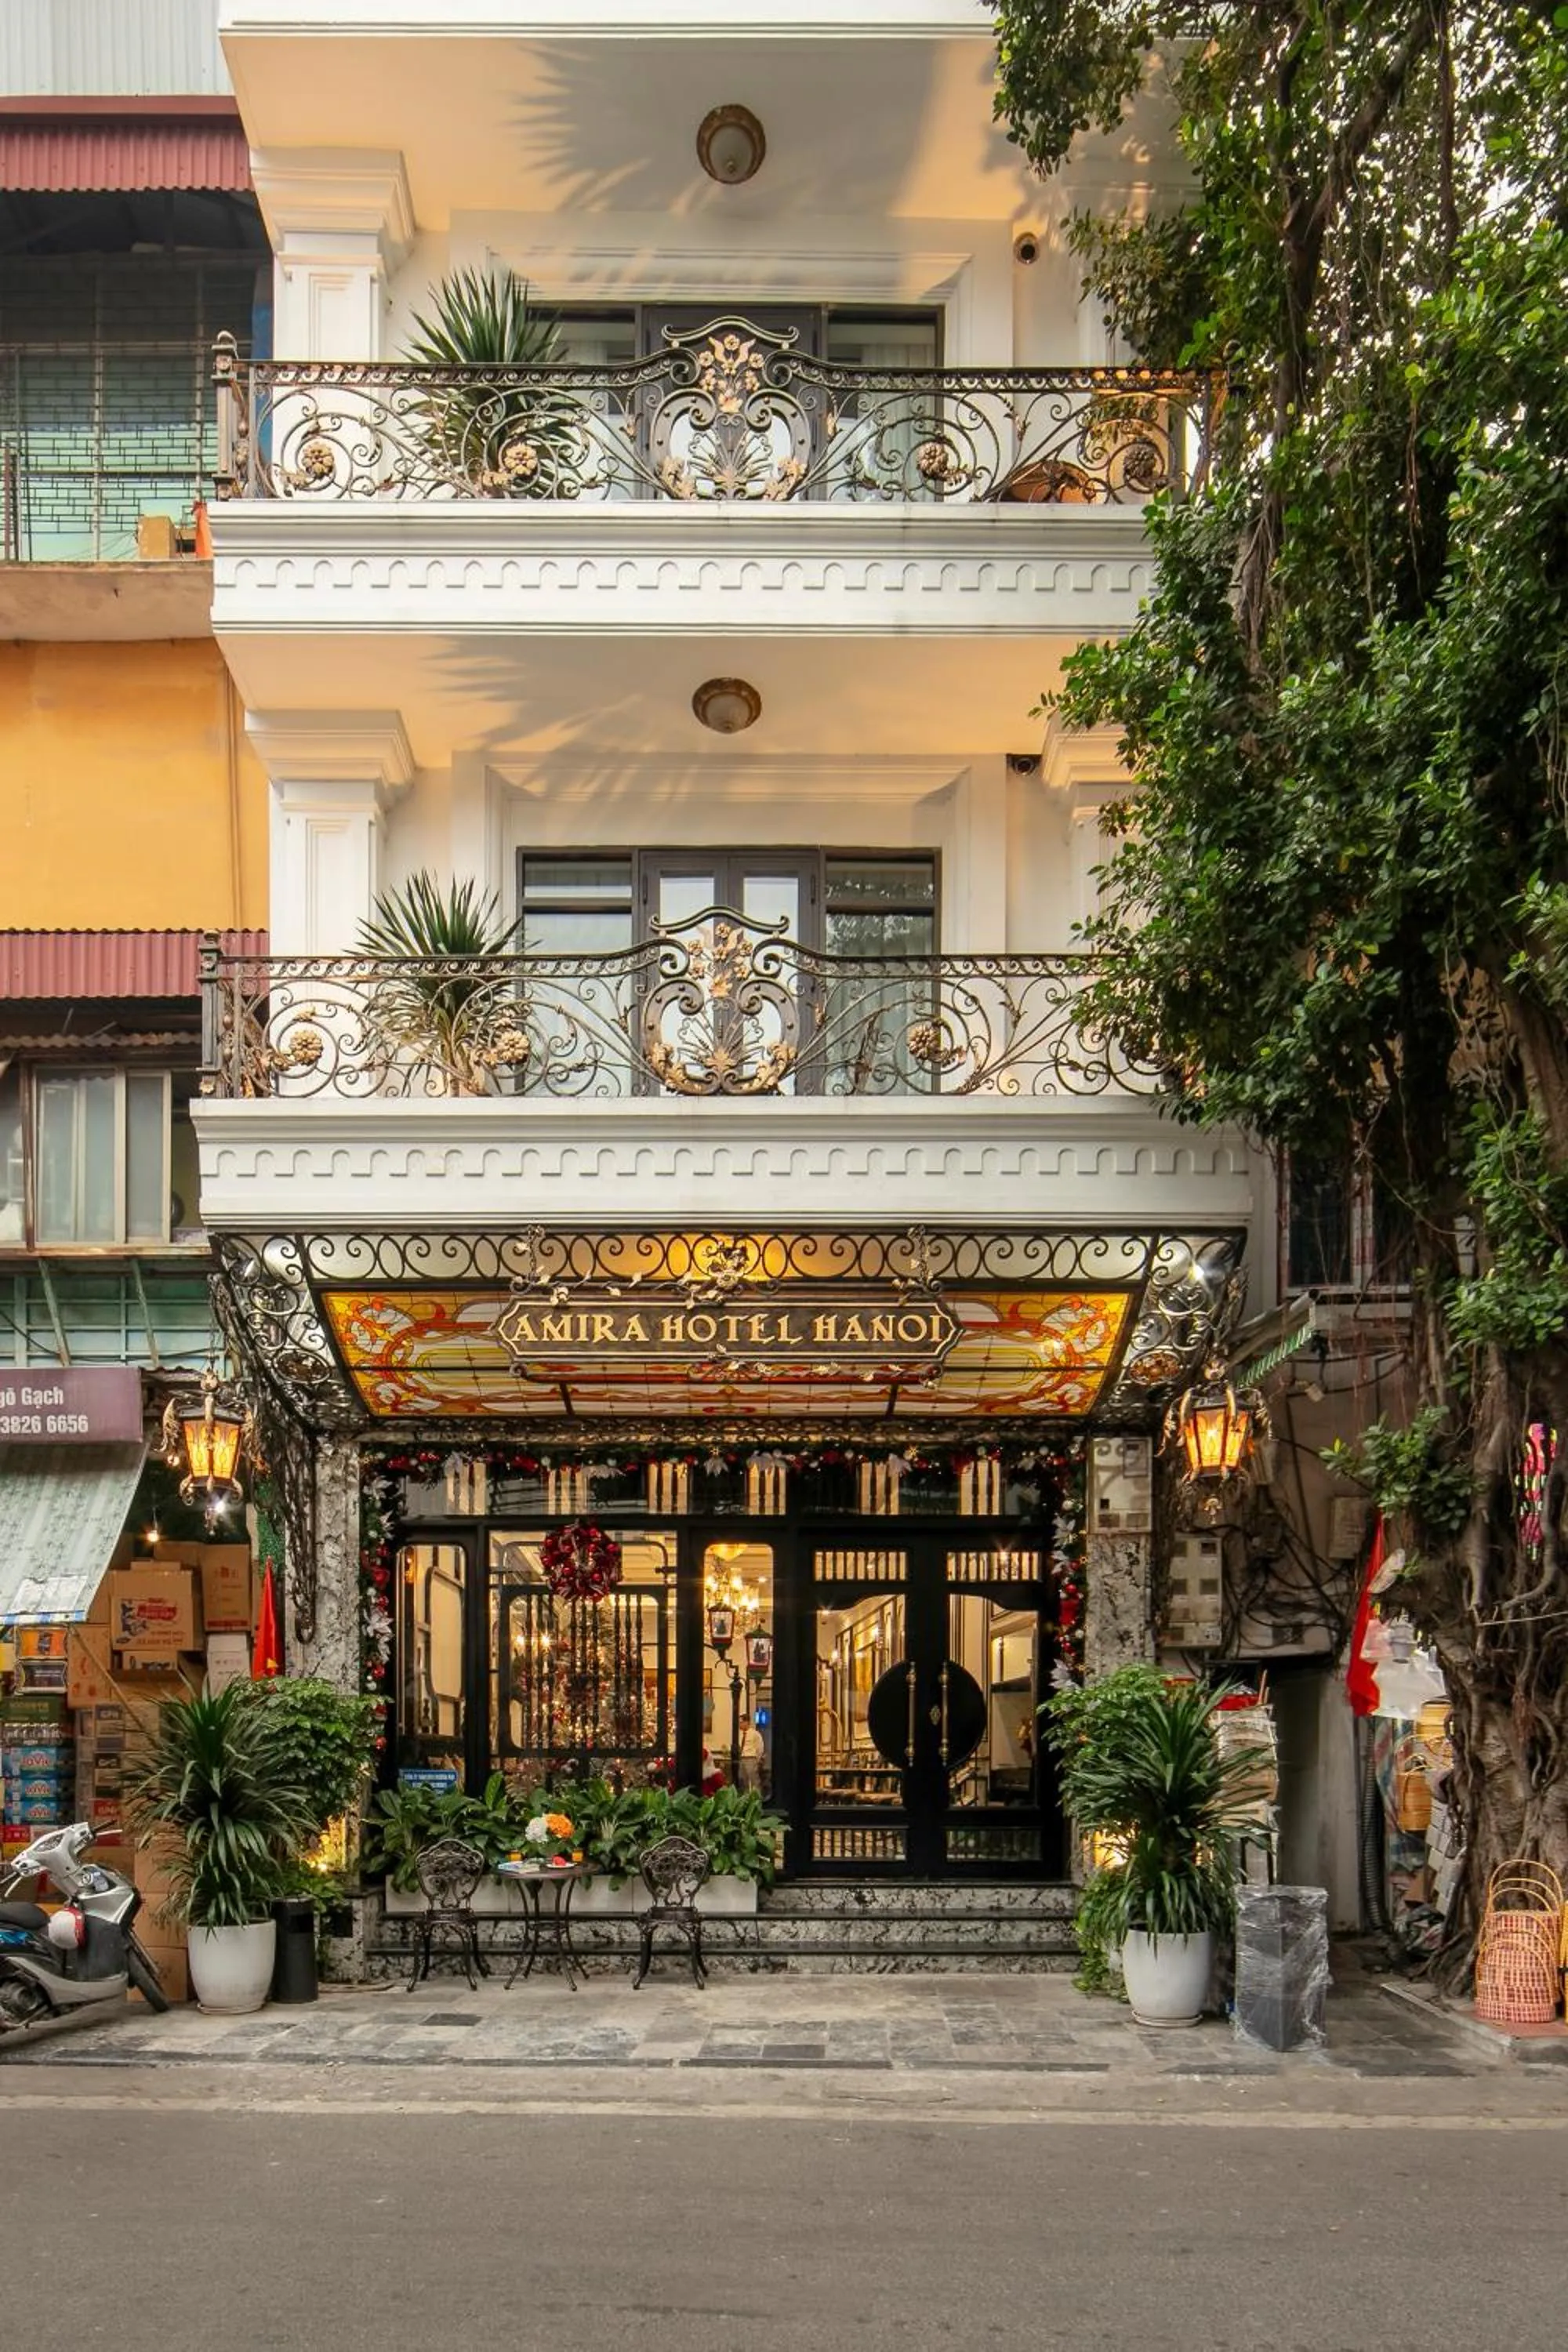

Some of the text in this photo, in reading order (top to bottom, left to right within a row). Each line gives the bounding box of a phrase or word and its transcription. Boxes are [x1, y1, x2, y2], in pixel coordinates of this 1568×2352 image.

[510, 1313, 943, 1345] AMIRA HOTEL HANOI
[21, 1386, 64, 1409] Gạch
[0, 1414, 89, 1434] 3826 6656
